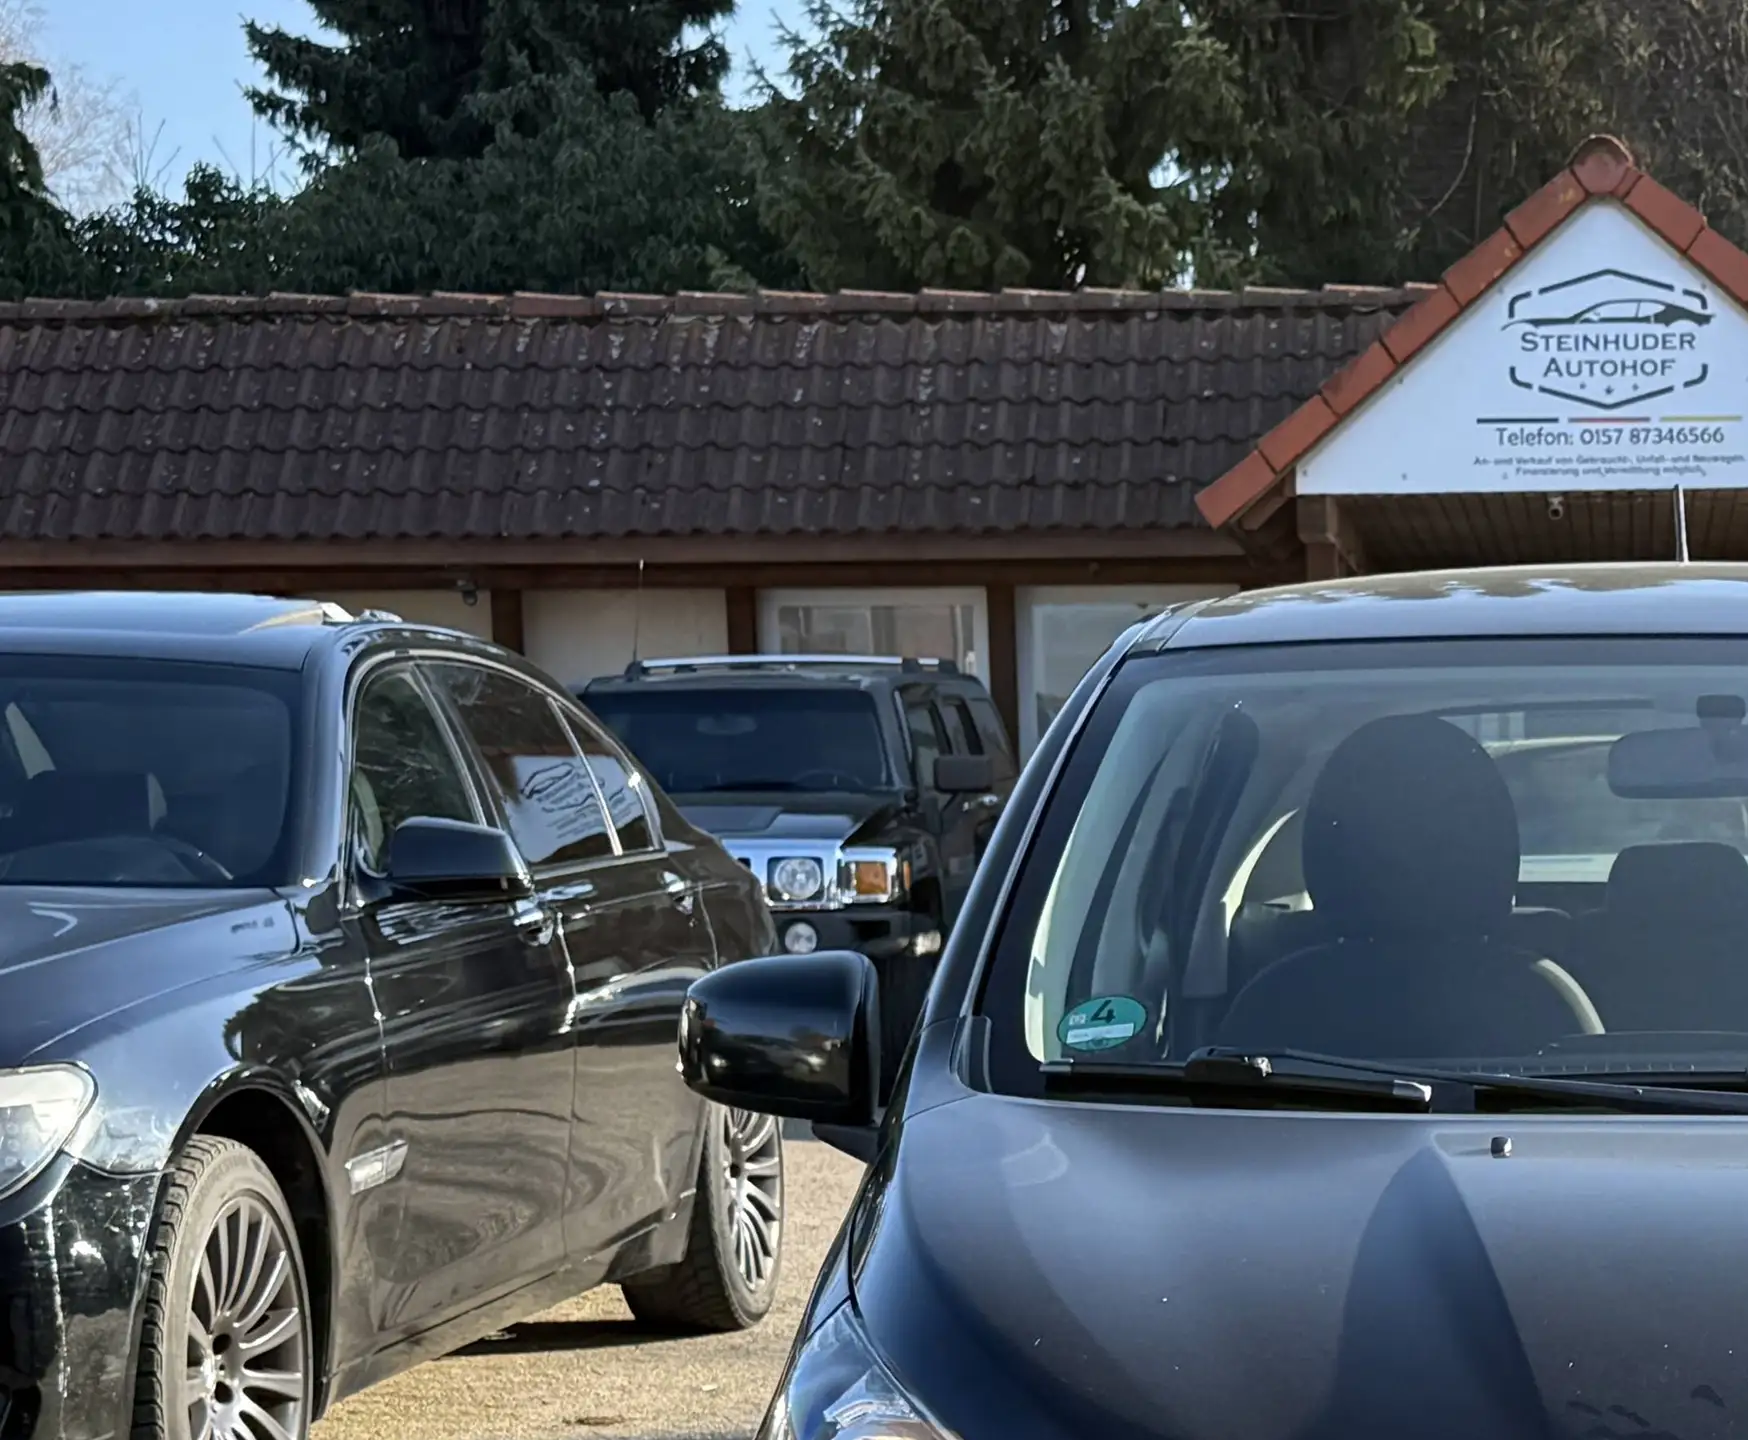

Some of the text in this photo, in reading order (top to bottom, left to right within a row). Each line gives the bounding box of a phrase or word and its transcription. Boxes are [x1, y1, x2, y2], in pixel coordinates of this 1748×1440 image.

[1520, 331, 1696, 352] STEINHUDER
[1543, 357, 1676, 378] AUTOHOF
[1495, 426, 1725, 446] Telefon: 0157 87346566
[1090, 999, 1116, 1024] 4
